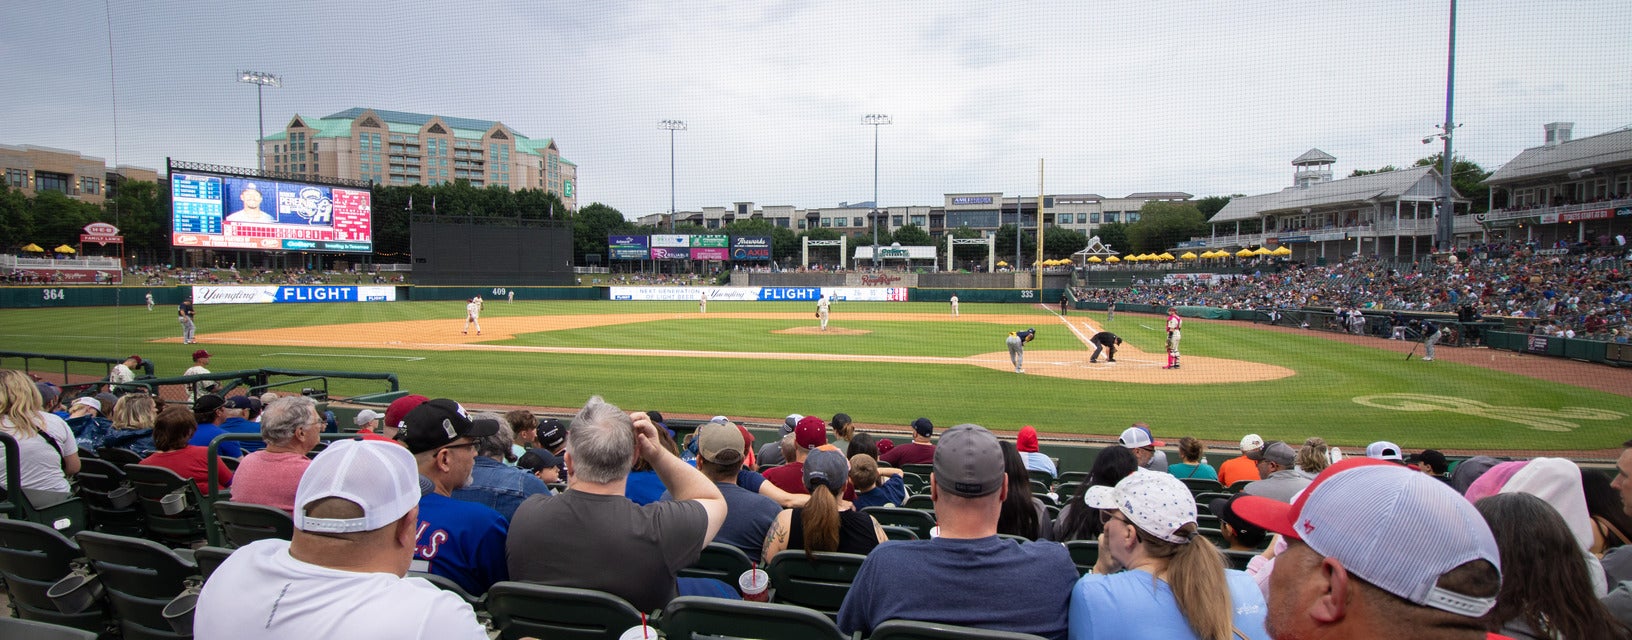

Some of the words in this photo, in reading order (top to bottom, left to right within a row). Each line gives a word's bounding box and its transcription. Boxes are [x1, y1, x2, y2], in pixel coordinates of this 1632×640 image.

[1564, 213, 1580, 221] TICKETS
[737, 237, 766, 246] Fireworks
[43, 289, 64, 300] 364
[198, 286, 256, 303] Yuengling
[284, 287, 351, 300] FLIGHT
[492, 287, 506, 296] 409
[708, 289, 745, 300] Yuengling
[764, 288, 815, 299] FLIGHT
[1021, 290, 1033, 298] 335
